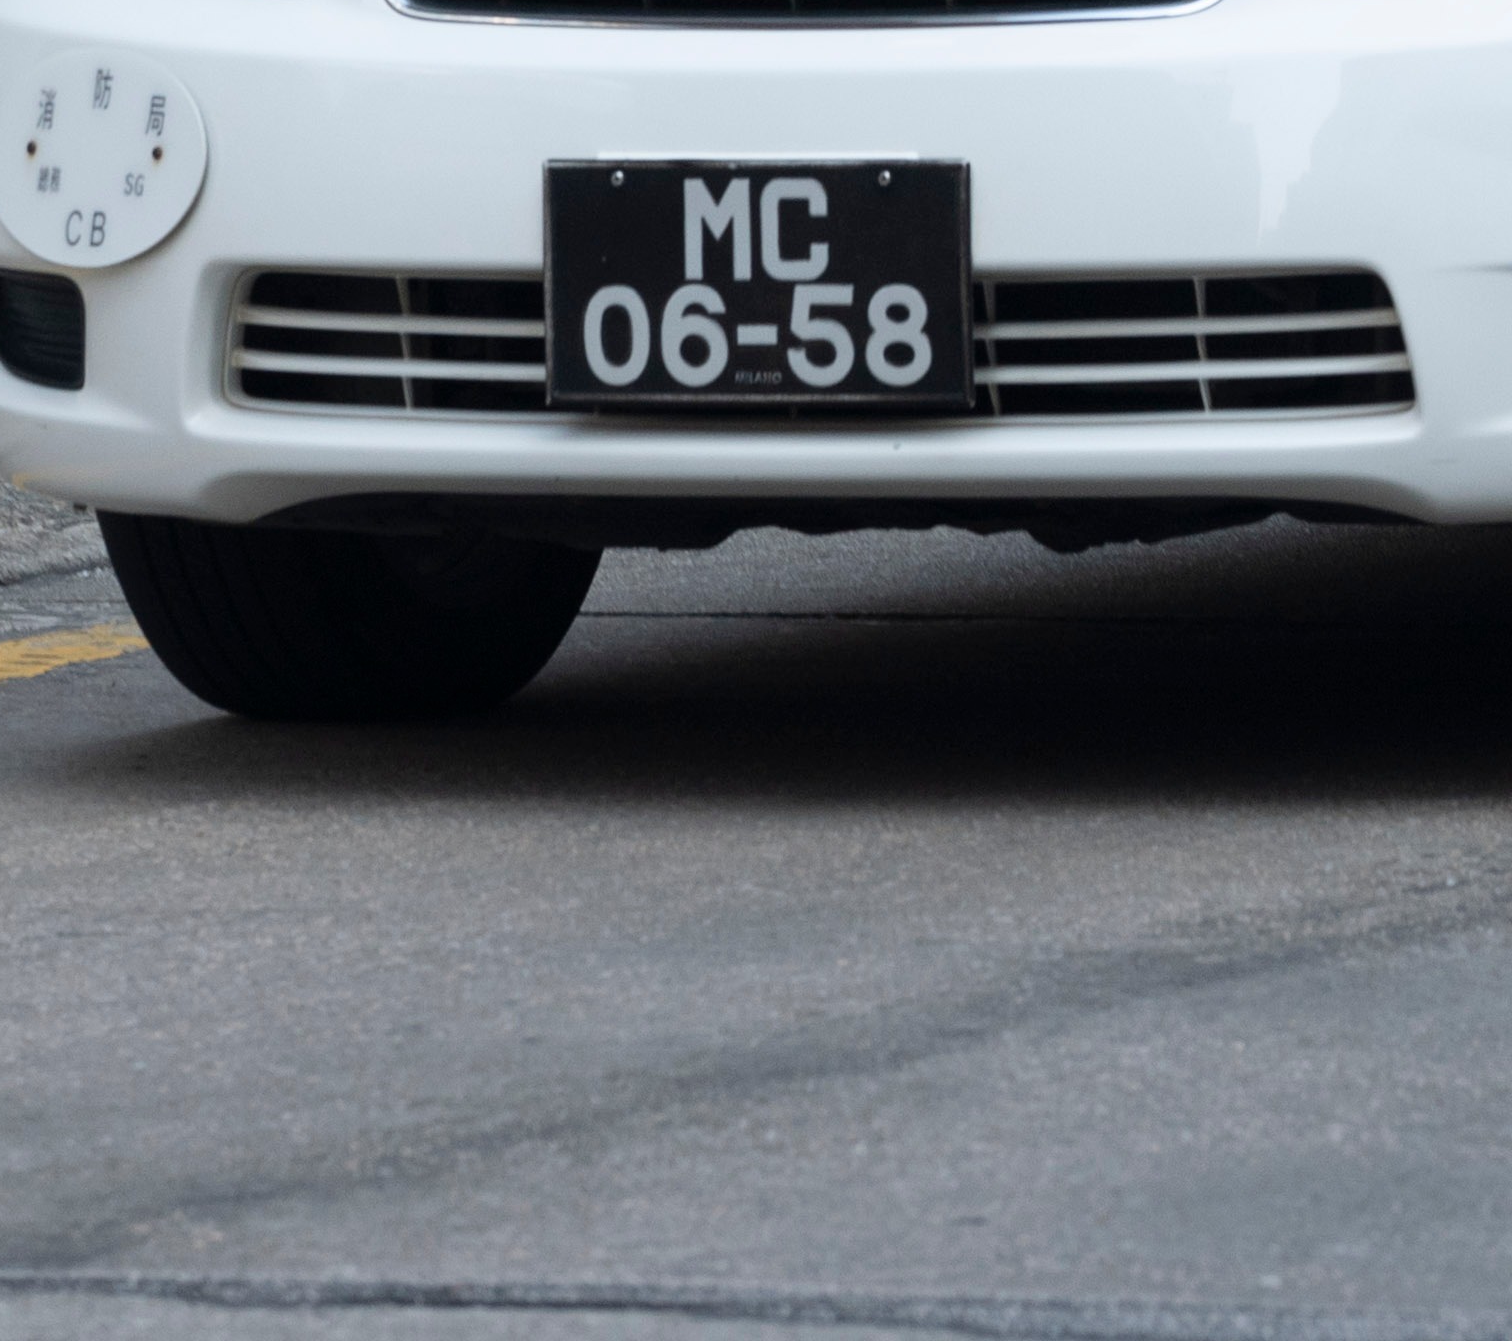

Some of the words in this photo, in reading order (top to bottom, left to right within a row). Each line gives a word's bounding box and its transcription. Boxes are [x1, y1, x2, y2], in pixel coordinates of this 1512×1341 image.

[65, 210, 107, 247] CB
[684, 177, 830, 281] MC
[583, 283, 933, 387] 06-58
